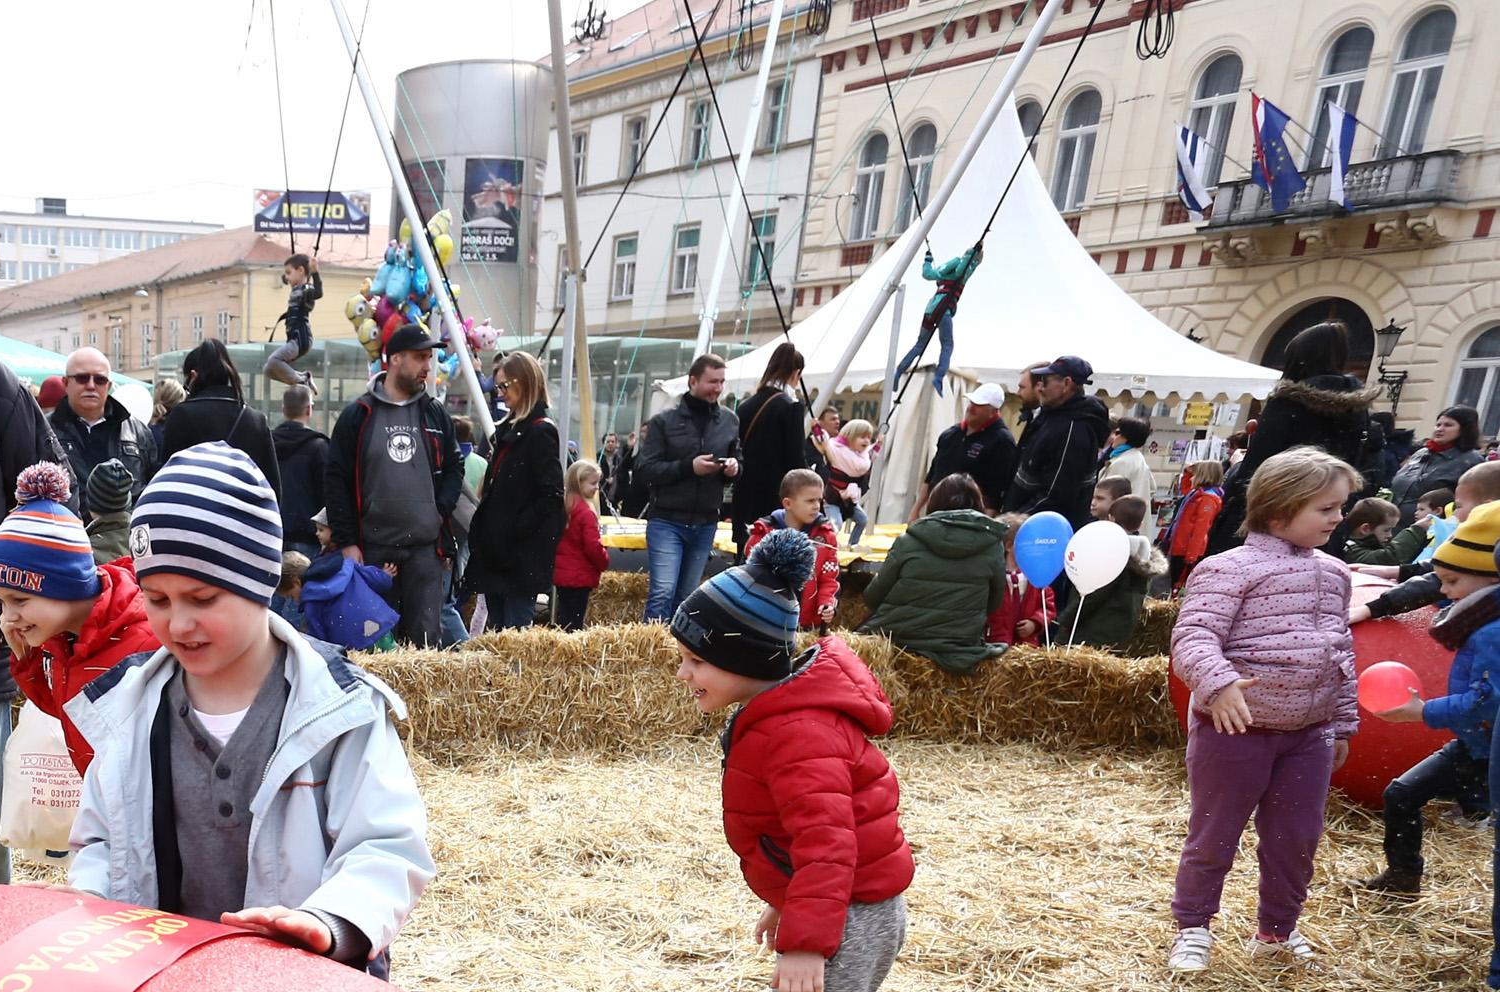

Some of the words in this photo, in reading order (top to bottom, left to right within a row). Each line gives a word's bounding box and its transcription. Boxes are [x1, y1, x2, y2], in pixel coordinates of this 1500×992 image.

[282, 202, 345, 219] METRO
[21, 757, 74, 767] "POTESTAS-
[32, 786, 46, 796] Tel.
[32, 796, 48, 806] Fax.
